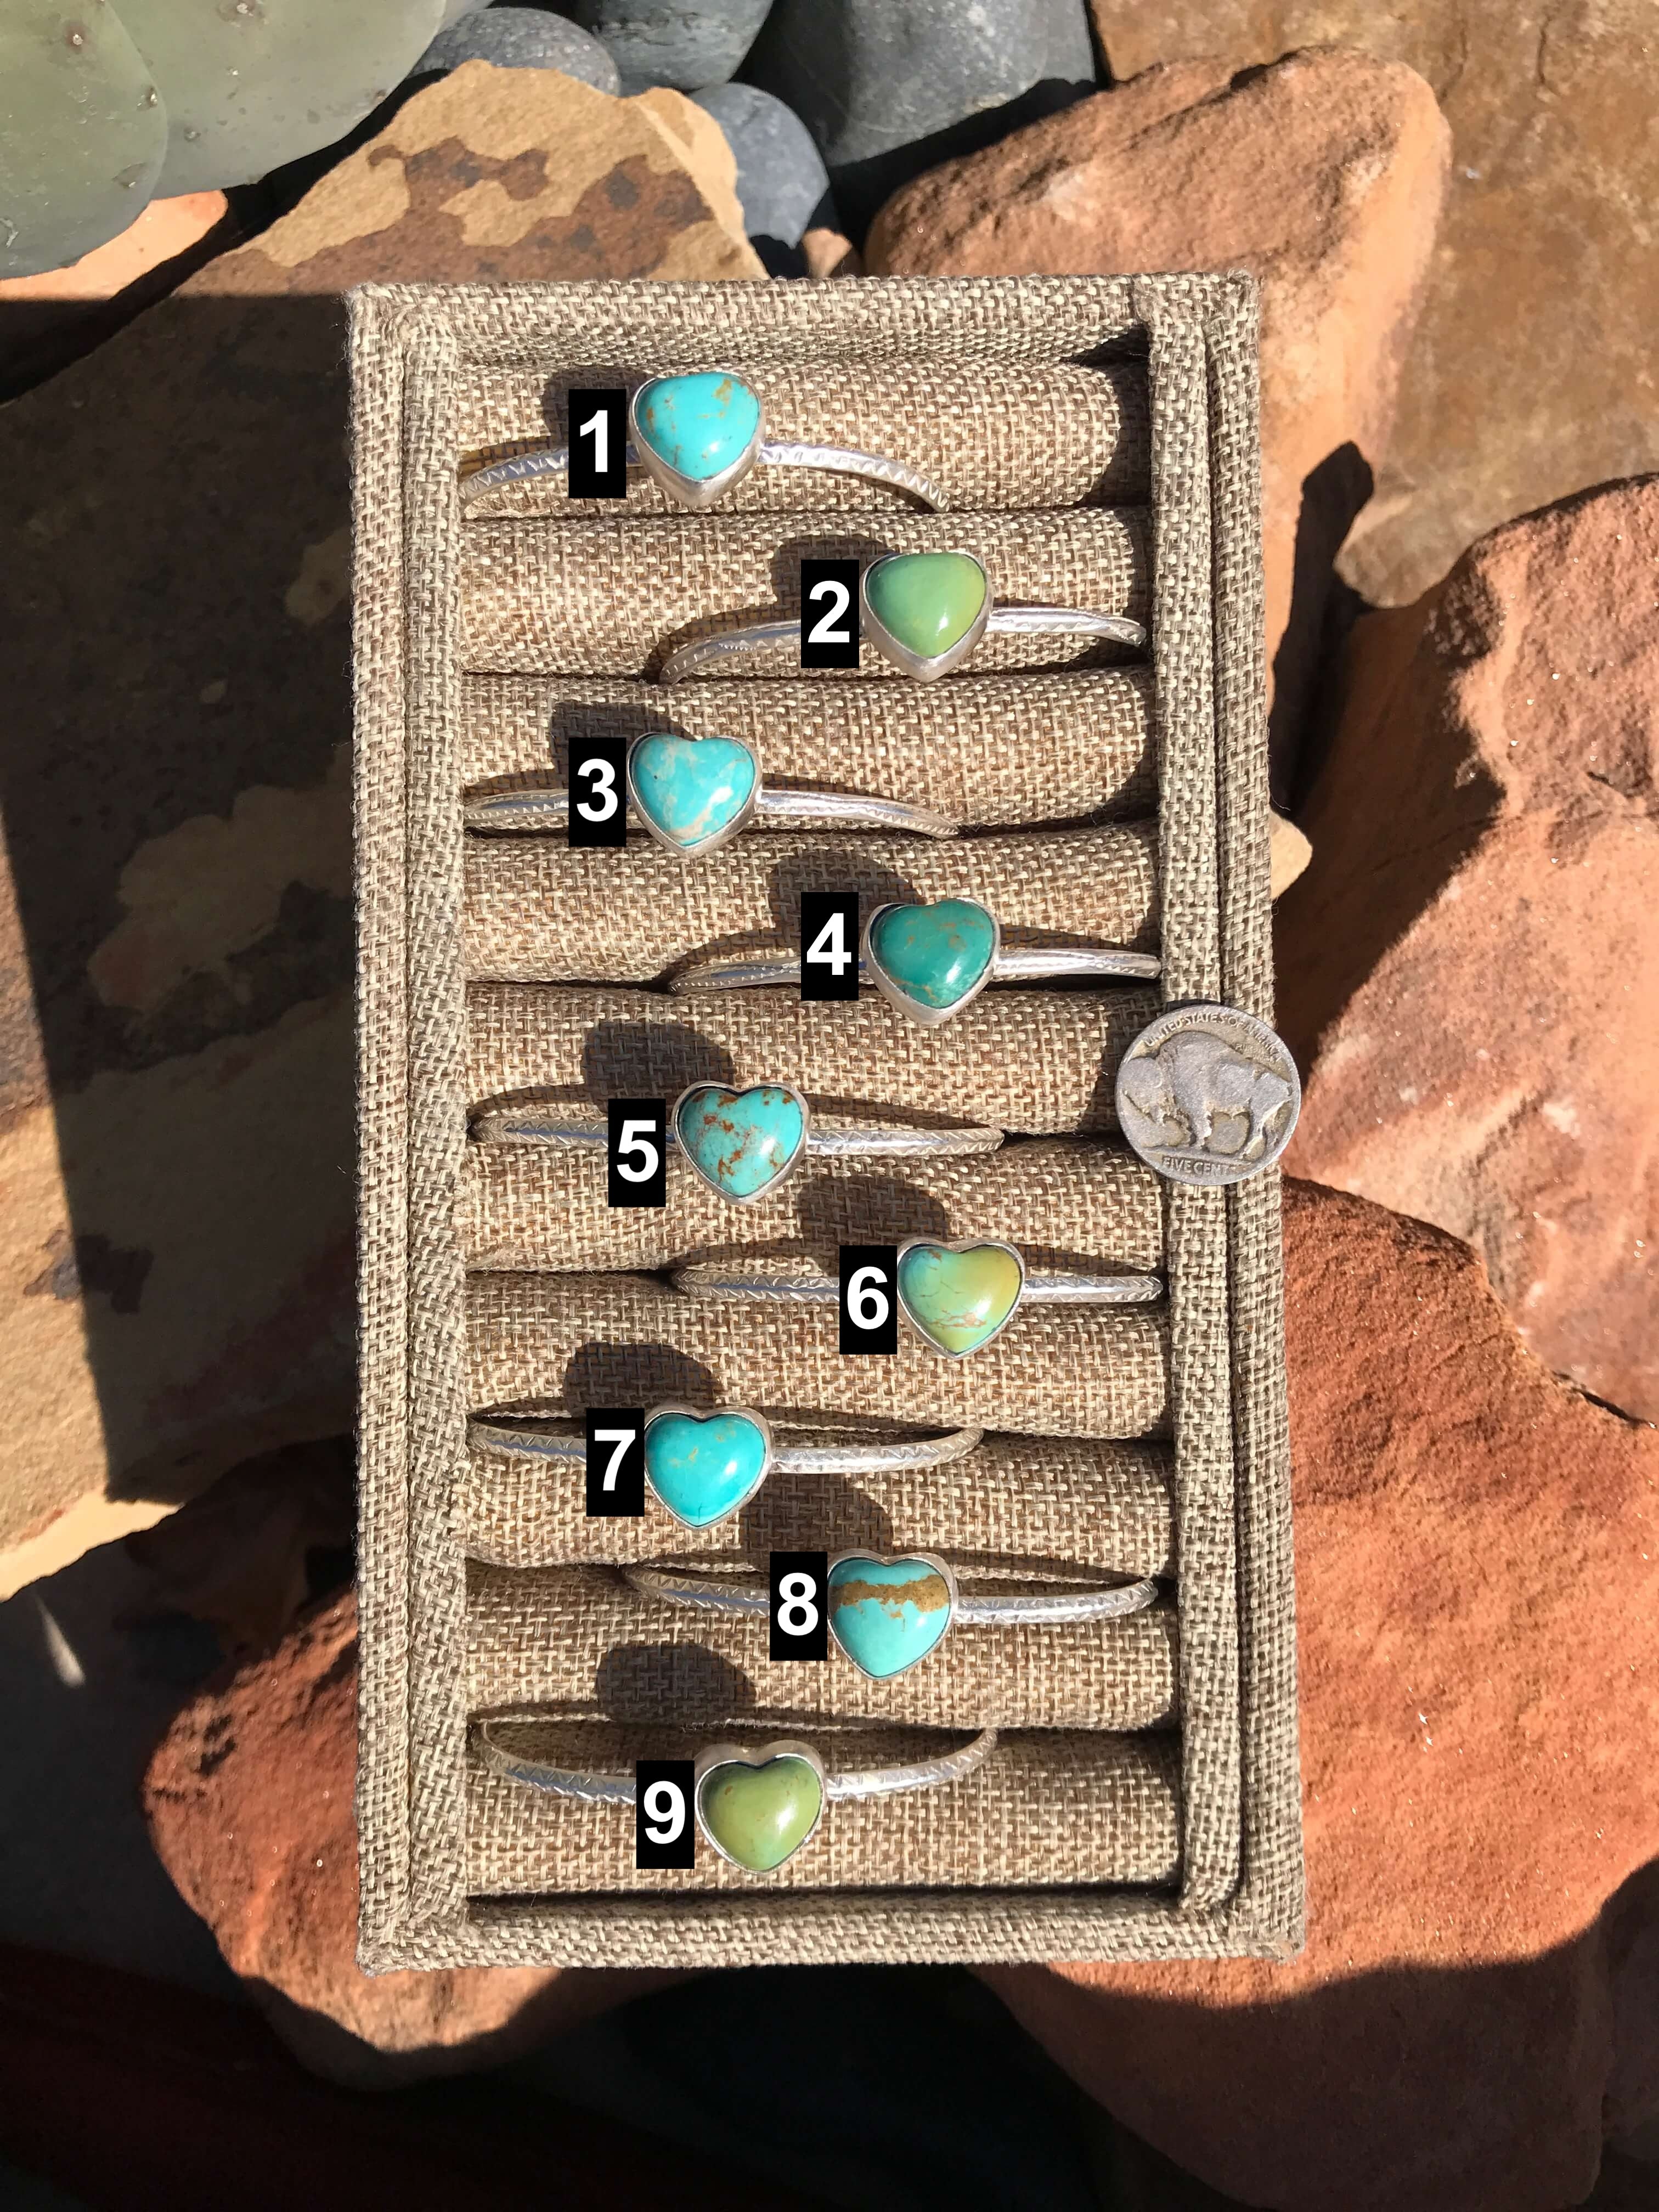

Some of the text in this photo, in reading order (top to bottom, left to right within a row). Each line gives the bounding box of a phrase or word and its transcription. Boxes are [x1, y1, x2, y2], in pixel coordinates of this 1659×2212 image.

[1144, 1018, 1183, 1046] UNITED
[1183, 1012, 1224, 1025] STATES
[1228, 1015, 1244, 1028] OF
[1162, 1156, 1235, 1177] FIVE CENT
